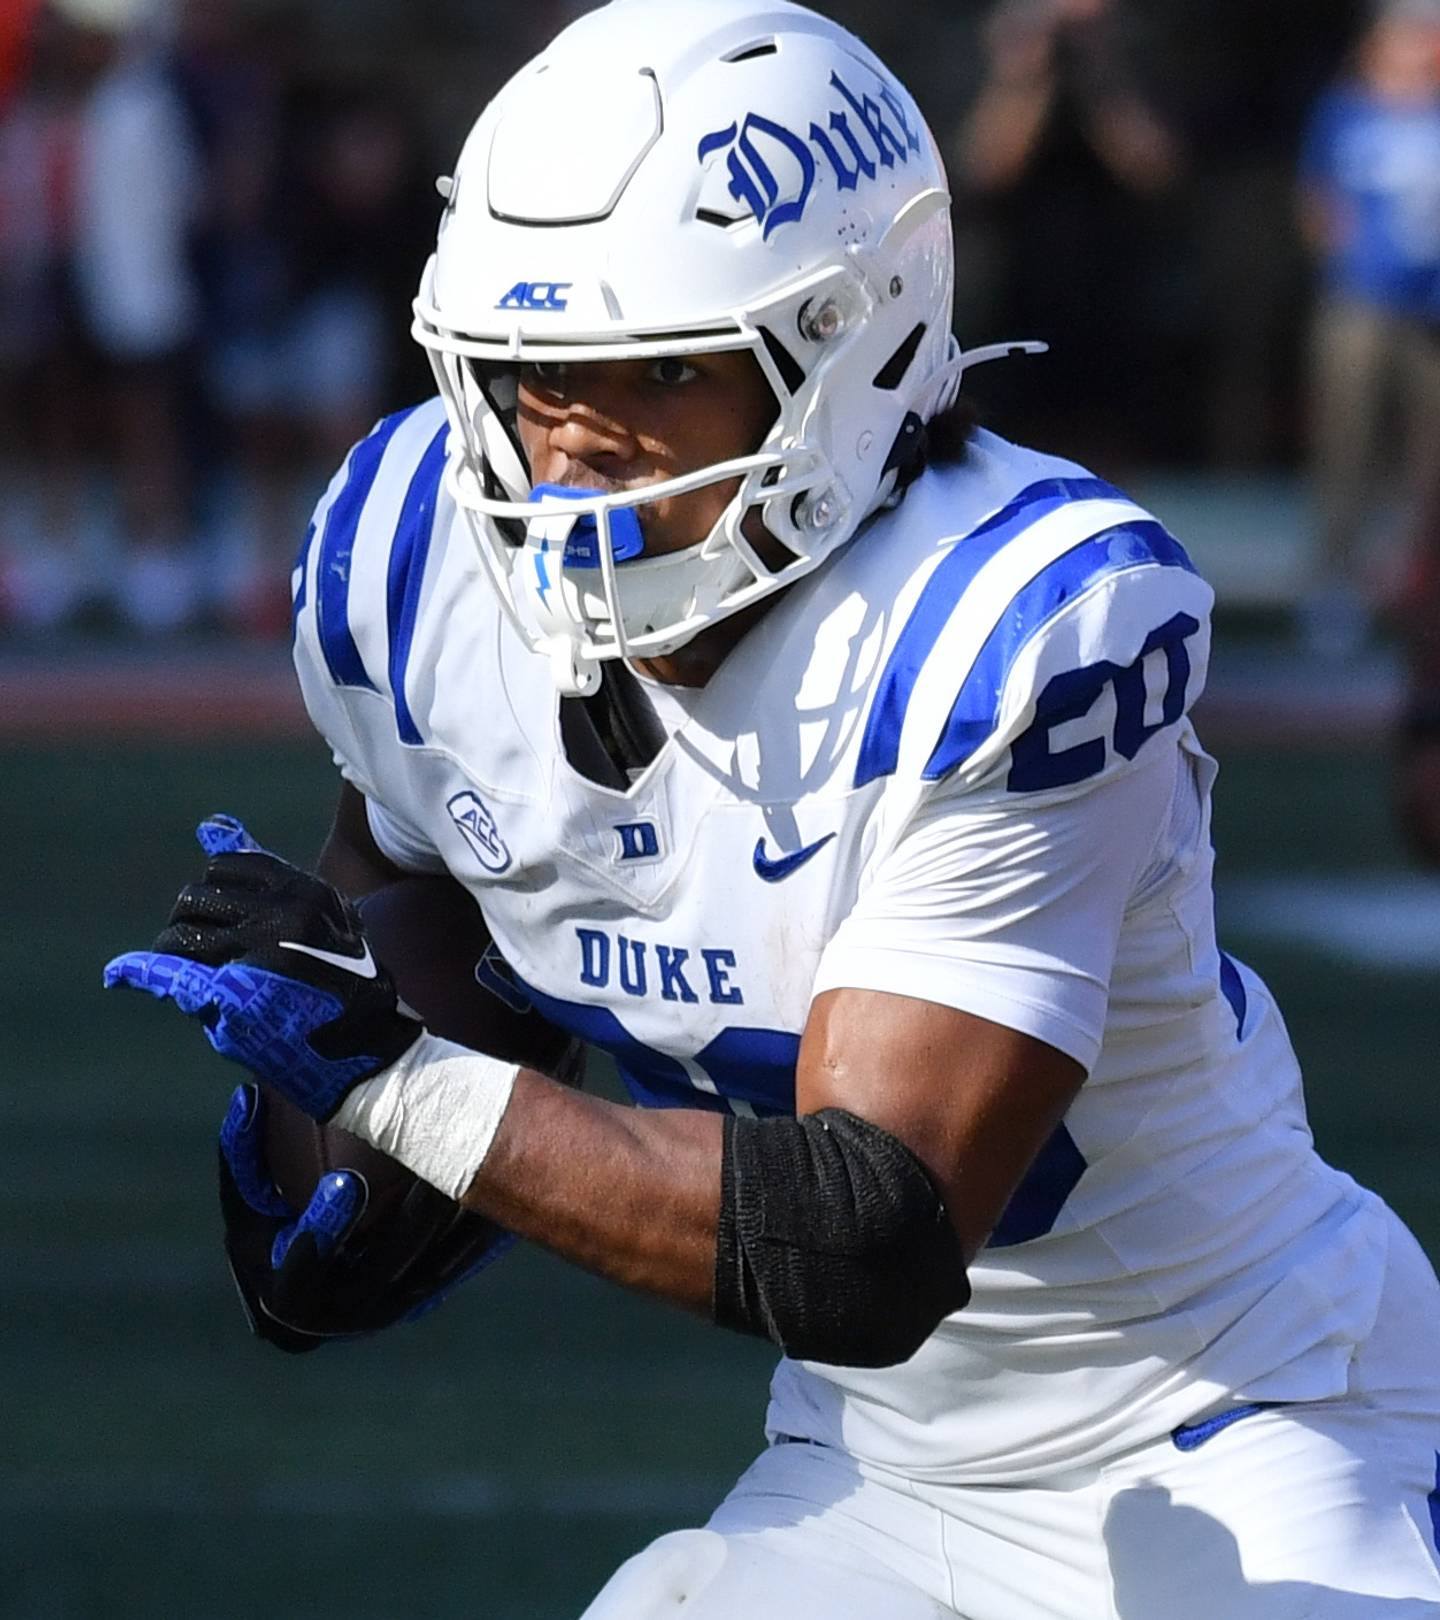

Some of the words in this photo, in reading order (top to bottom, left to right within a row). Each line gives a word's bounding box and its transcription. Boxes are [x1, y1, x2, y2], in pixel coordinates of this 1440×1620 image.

[697, 69, 920, 242] Duke
[494, 281, 573, 312] ACC
[1006, 611, 1200, 792] 20
[460, 808, 502, 860] ACC
[576, 929, 744, 1005] DUKE
